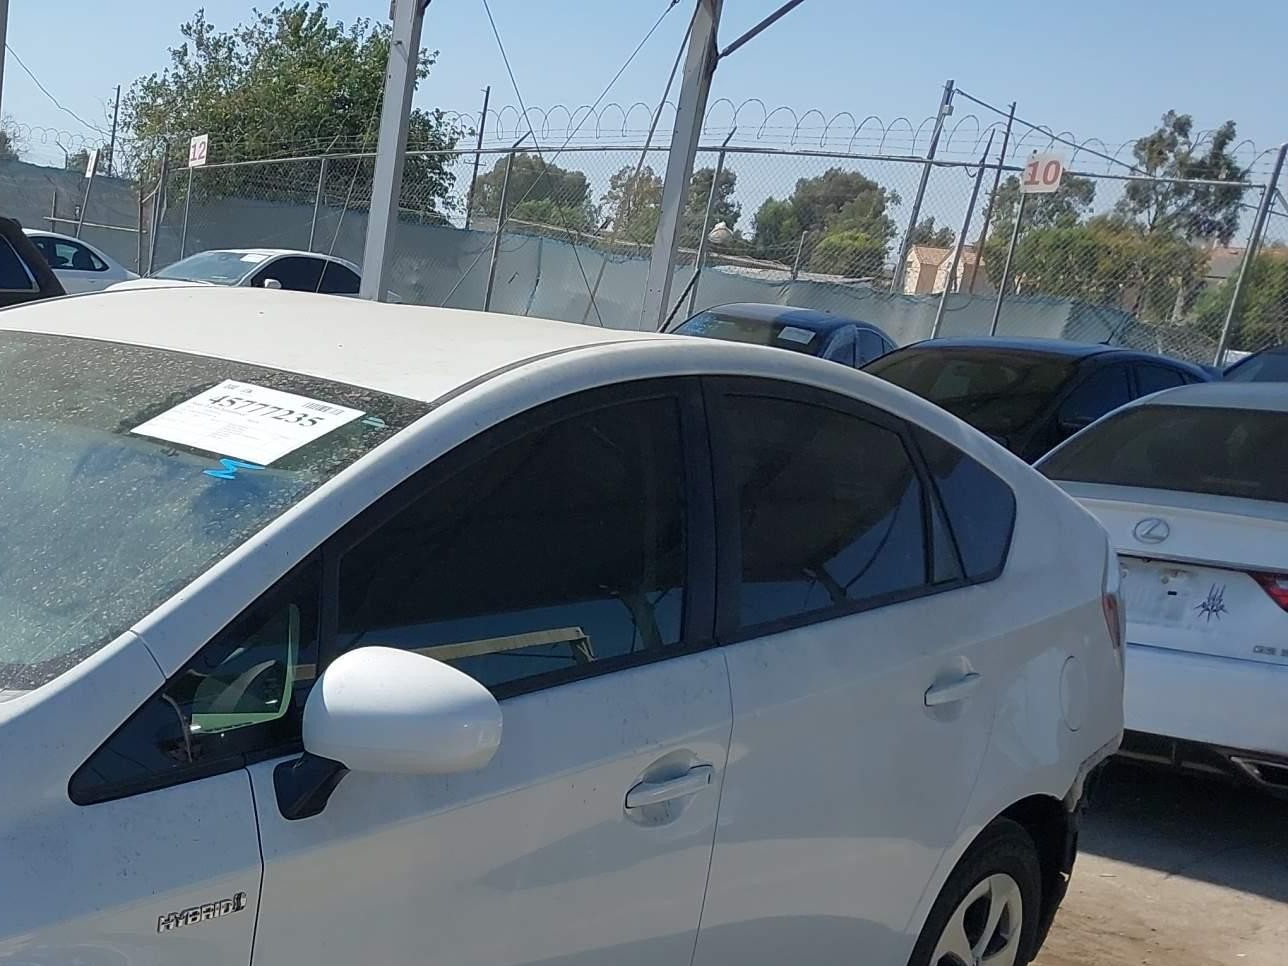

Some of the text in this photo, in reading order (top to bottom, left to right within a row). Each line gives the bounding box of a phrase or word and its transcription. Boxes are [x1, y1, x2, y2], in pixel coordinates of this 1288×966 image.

[191, 141, 206, 161] 12
[1024, 160, 1061, 186] 10
[208, 395, 325, 427] 45777235
[158, 898, 233, 933] HYBRID
